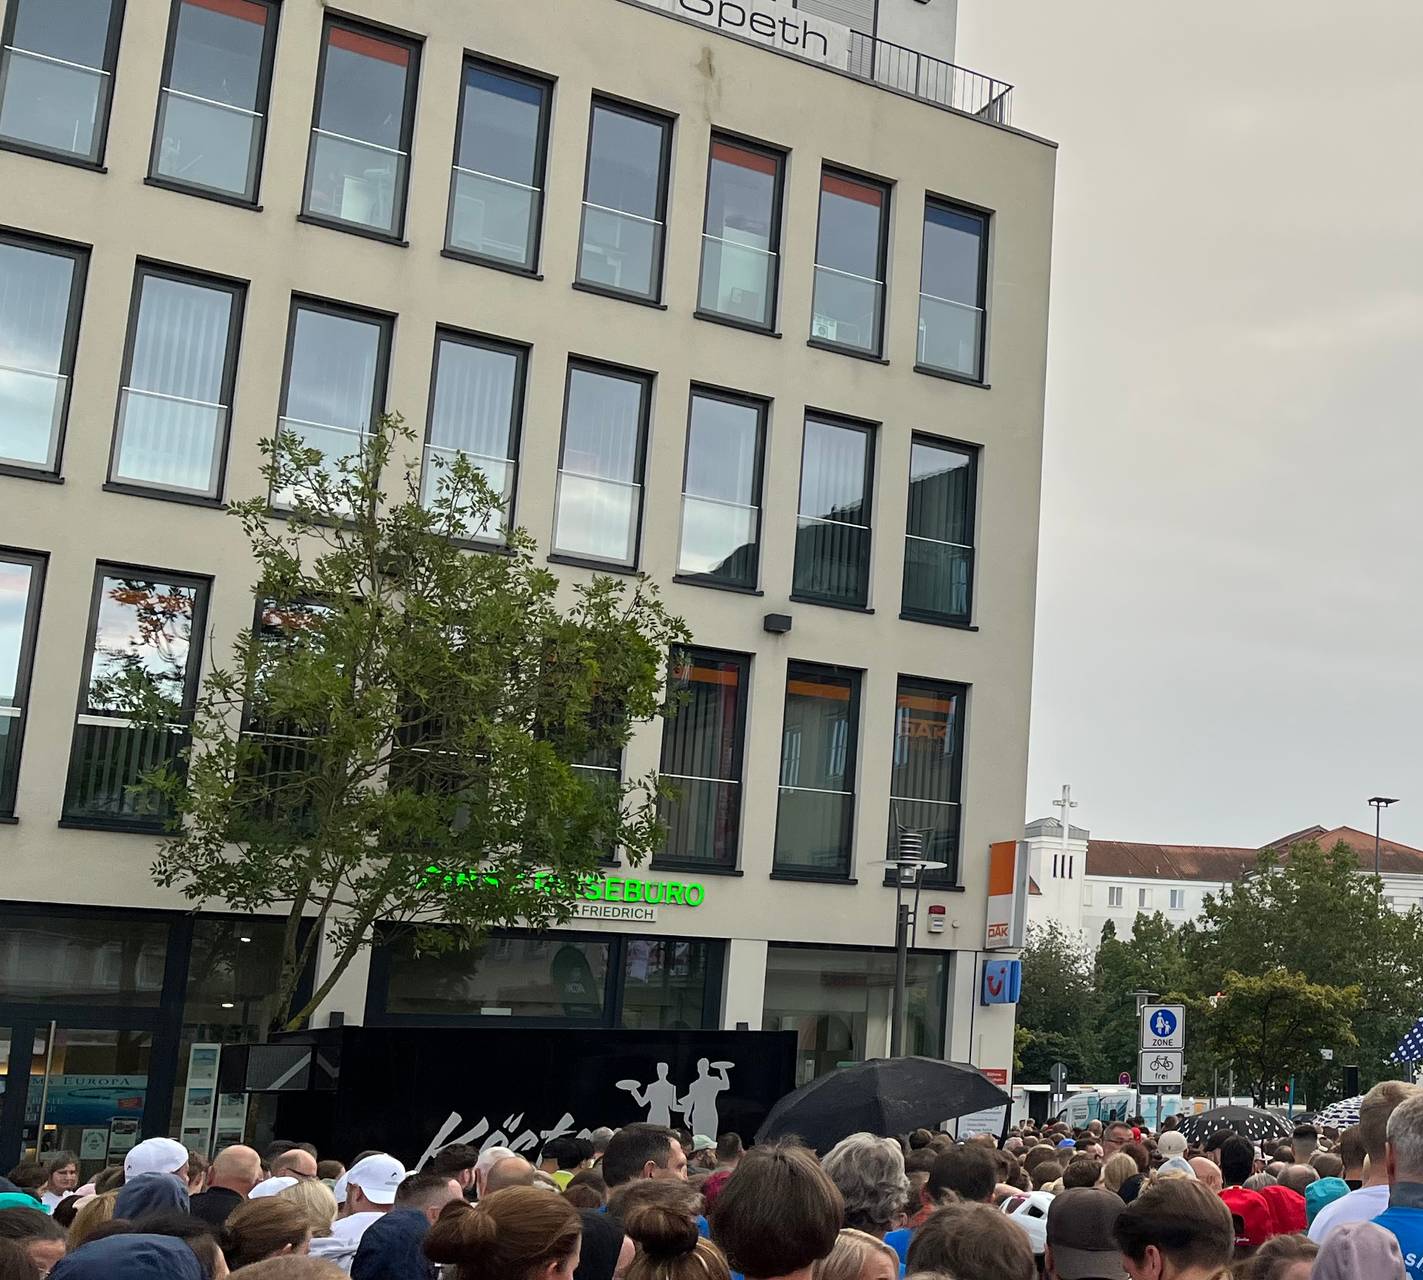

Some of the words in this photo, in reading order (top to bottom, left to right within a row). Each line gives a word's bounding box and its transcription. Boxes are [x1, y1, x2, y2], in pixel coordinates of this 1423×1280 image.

[582, 905, 654, 919] FRIEDRICH
[988, 925, 1008, 937] DAK
[1152, 1038, 1174, 1046] ZONE
[1154, 1072, 1168, 1080] frei
